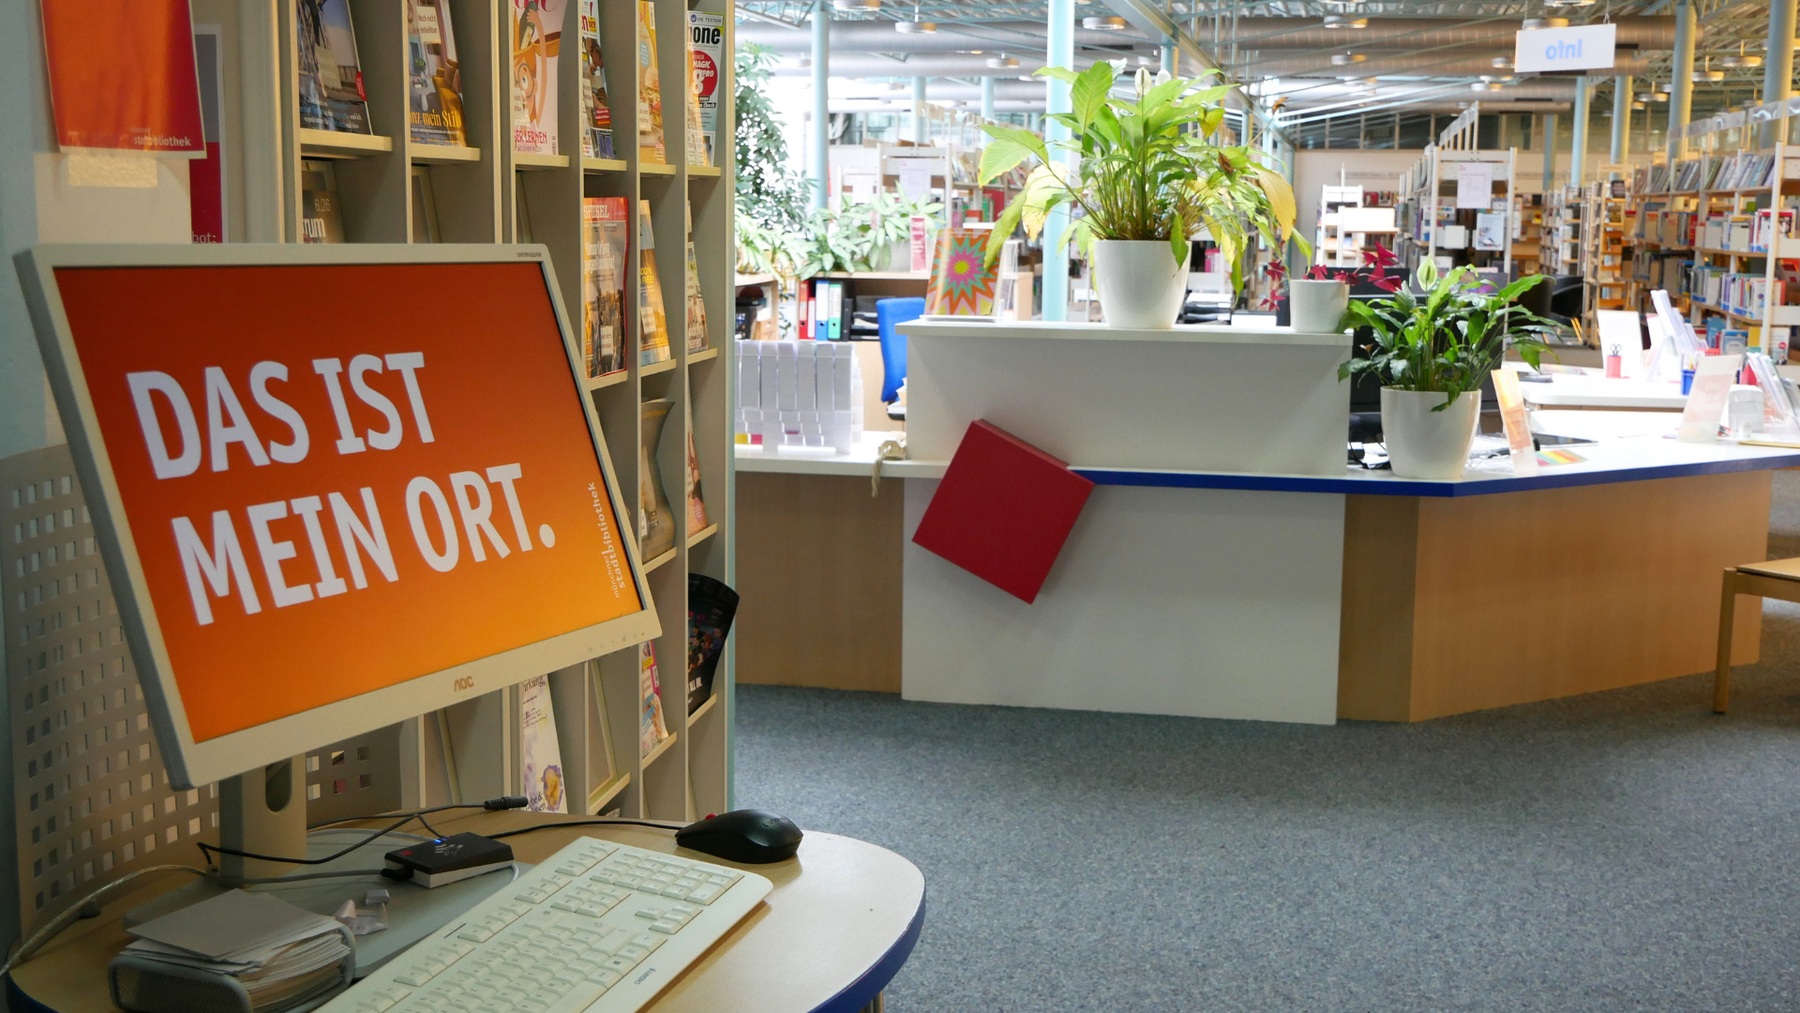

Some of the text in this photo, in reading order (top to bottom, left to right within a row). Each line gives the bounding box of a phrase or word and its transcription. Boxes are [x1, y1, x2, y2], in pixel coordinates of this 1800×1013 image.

[526, 130, 548, 144] LERNEN
[126, 351, 435, 480] DAS IST
[171, 462, 556, 626] MEIN ORT.
[587, 481, 626, 589] stadtbibliothek
[454, 676, 475, 692] AOC
